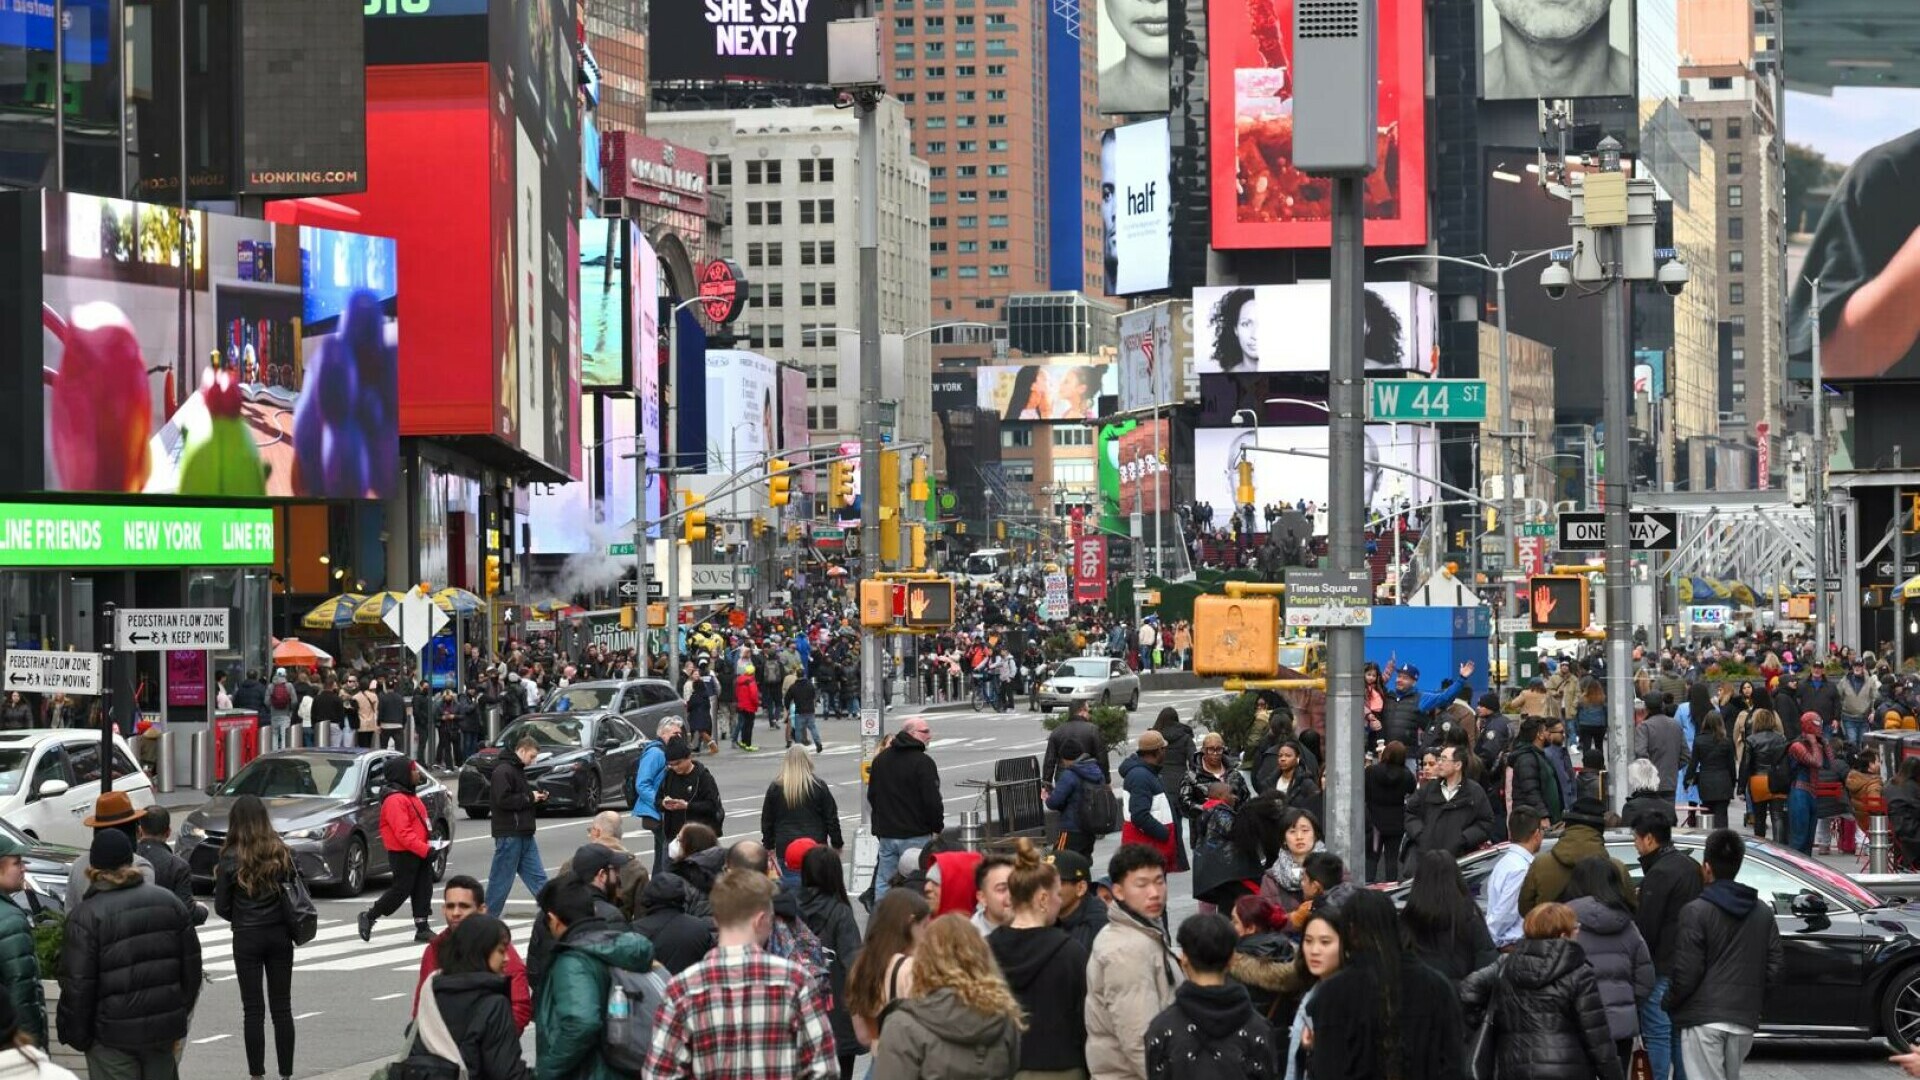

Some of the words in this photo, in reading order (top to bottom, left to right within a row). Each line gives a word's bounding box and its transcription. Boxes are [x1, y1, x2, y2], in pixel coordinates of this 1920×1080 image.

[705, 0, 753, 22] SHE
[761, 0, 808, 23] SAY
[717, 25, 797, 55] NEXT?
[251, 172, 357, 184] LIONKING.COM
[1128, 181, 1155, 215] half
[942, 382, 962, 391] YORK
[1378, 385, 1399, 416] W
[1411, 385, 1449, 416] 44
[1463, 386, 1479, 401] ST
[36, 518, 102, 550] FRIENDS
[124, 520, 160, 551] NEW
[161, 520, 203, 551] YORK
[222, 521, 251, 551] LINE
[1525, 527, 1532, 535] W
[1536, 526, 1546, 534] 45
[1576, 525, 1606, 539] ONE
[1082, 540, 1101, 578] tkts
[1290, 584, 1320, 593] Times
[1322, 583, 1358, 595] Square
[1343, 596, 1368, 605] Plaza
[128, 614, 178, 627] PEDESTRIAN
[180, 614, 201, 627] FLOW
[204, 614, 224, 627] ZONE
[172, 631, 191, 644] KEEP
[193, 631, 224, 643] MOVING
[9, 655, 50, 669] PEDESTRIAN
[52, 656, 70, 670] FLOW
[72, 658, 91, 671] ZONE
[63, 674, 91, 688] MOVING
